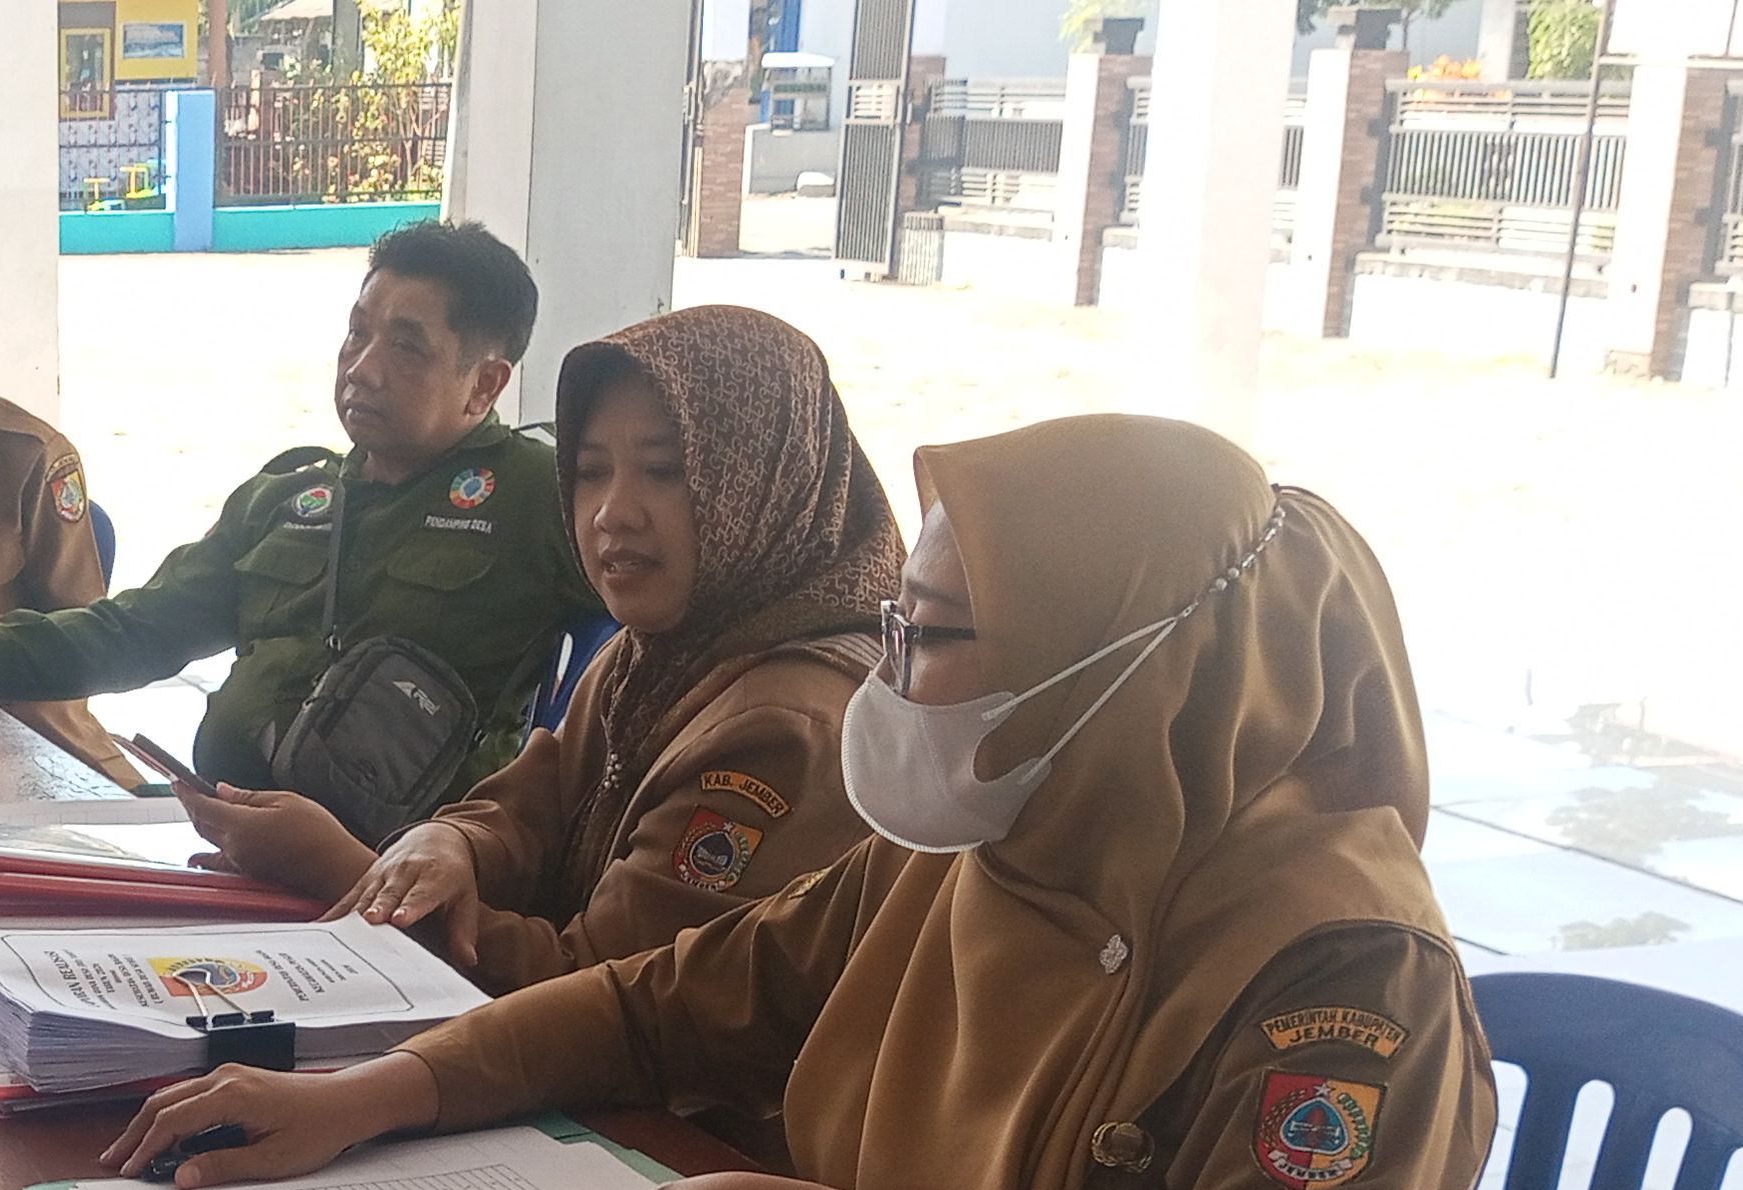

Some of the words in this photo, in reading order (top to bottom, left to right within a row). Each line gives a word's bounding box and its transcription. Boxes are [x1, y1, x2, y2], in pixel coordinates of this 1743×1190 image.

[704, 774, 733, 787] KAB.
[739, 779, 784, 815] JEMBER
[1265, 1010, 1338, 1034] PEMERINTAH
[1342, 1011, 1401, 1042] KABUPATEN
[1289, 1025, 1379, 1048] JEMBER
